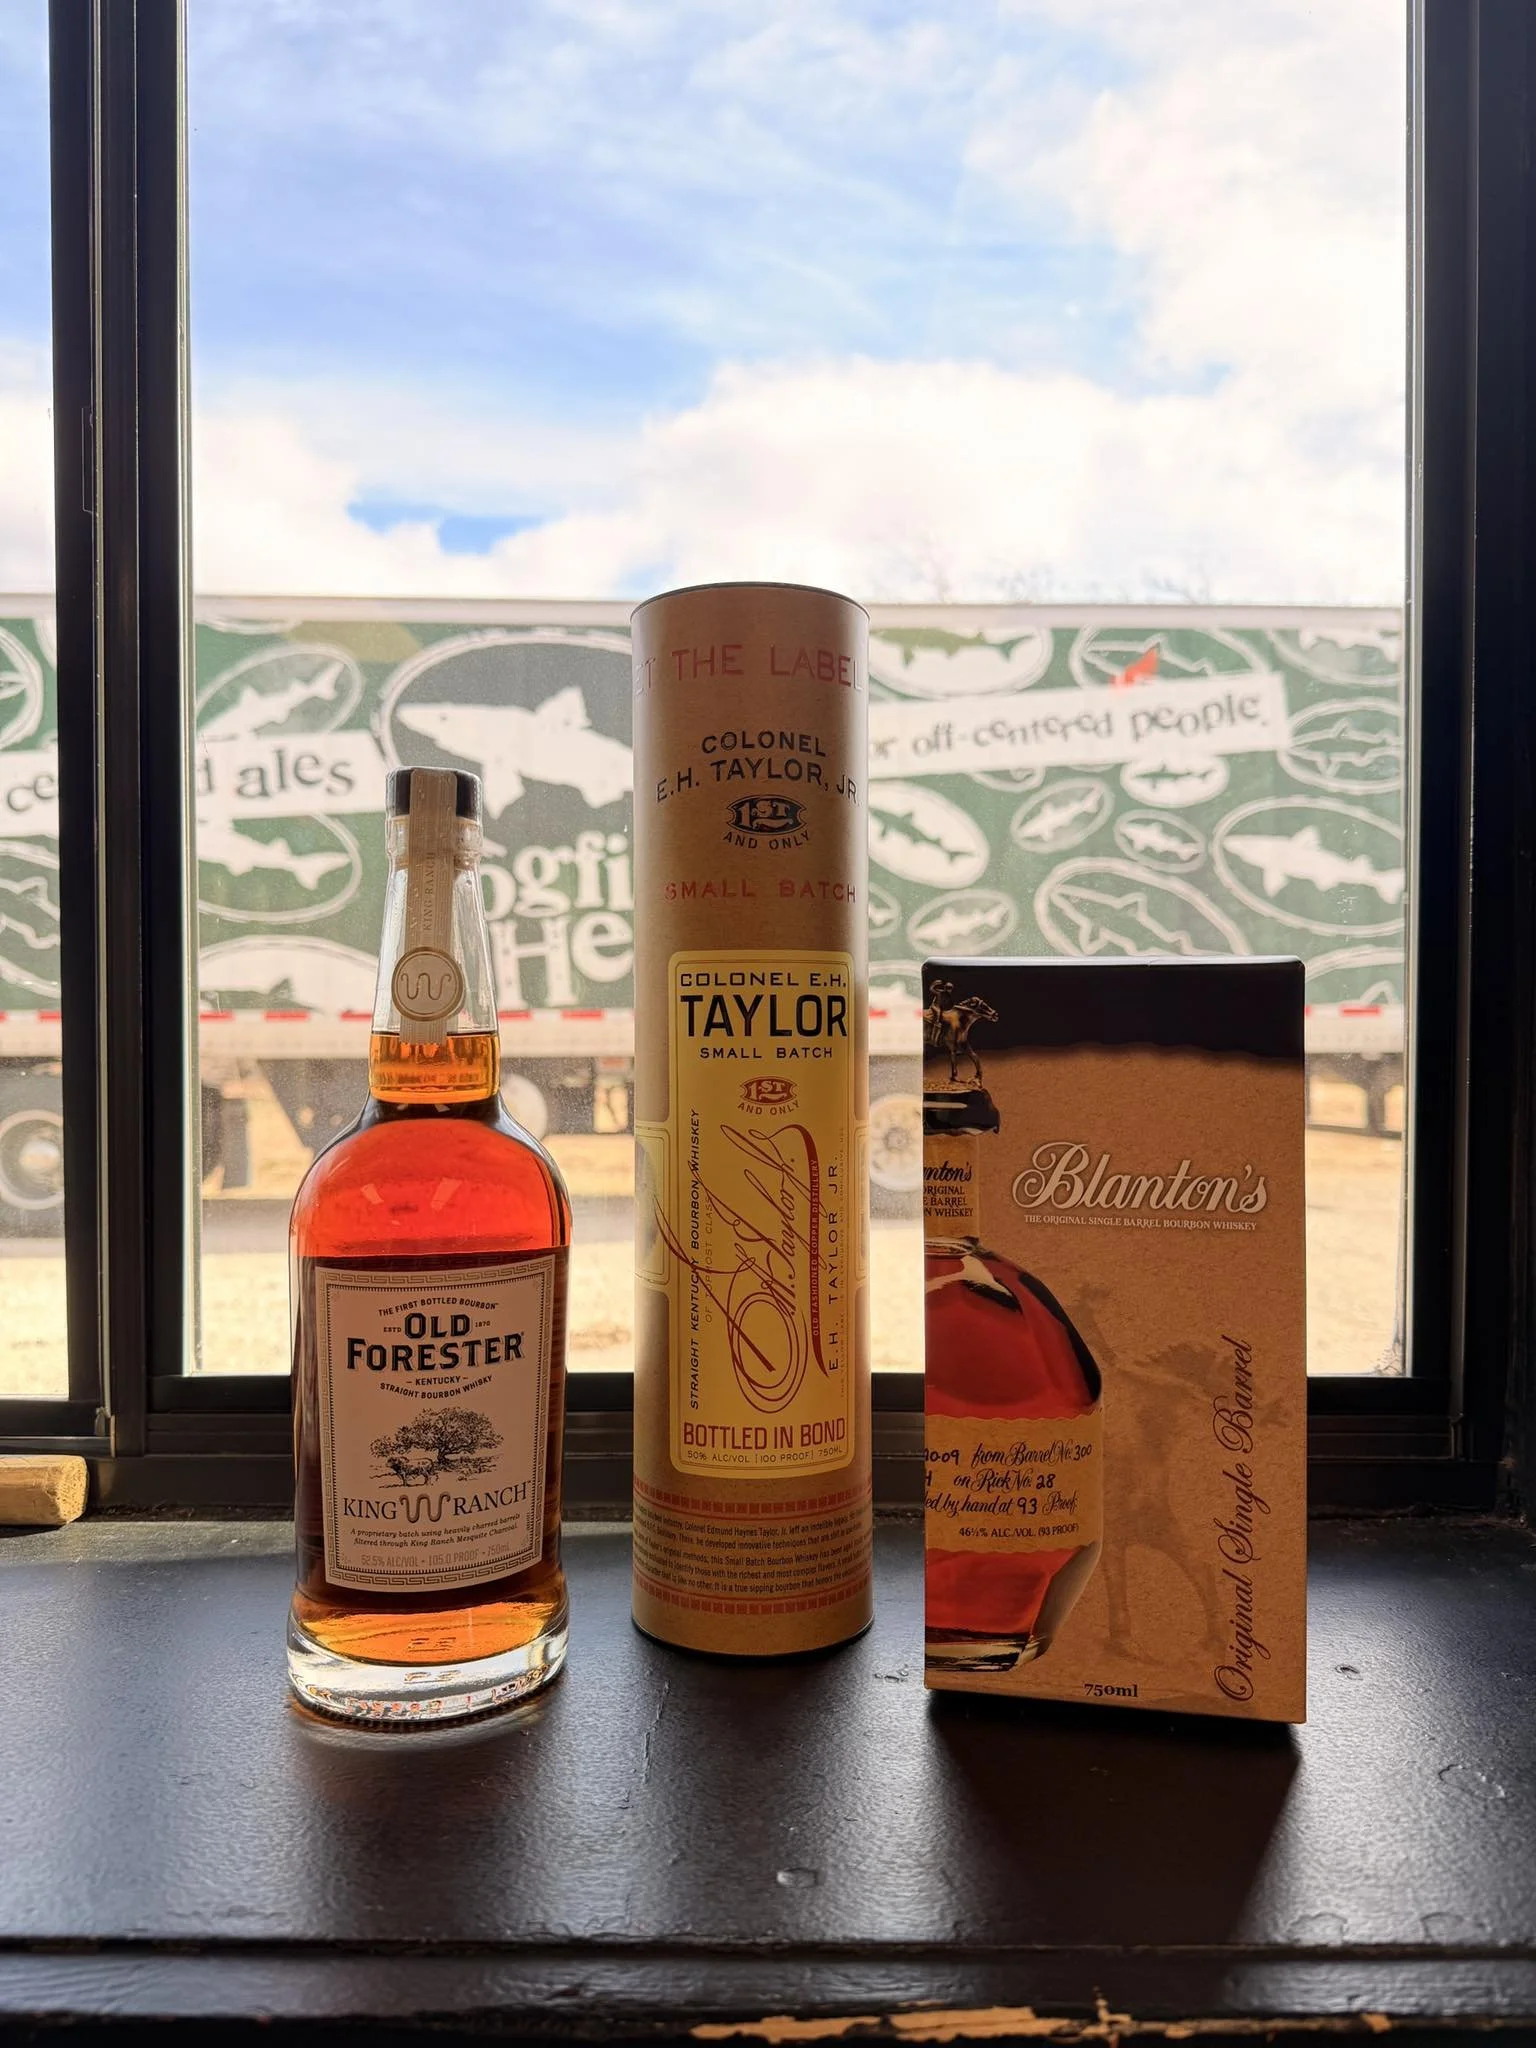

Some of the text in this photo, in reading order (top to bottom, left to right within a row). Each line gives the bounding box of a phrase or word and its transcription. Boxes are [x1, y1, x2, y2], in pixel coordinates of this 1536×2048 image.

[671, 644, 744, 681] THE
[770, 645, 863, 691] LABEL
[912, 712, 1113, 757] off-centered
[1130, 693, 1268, 742] people.
[702, 731, 826, 757] COLONEL
[235, 749, 356, 799] ales
[657, 768, 700, 803] E.H.
[710, 758, 829, 791] TAYLOR,
[739, 800, 791, 828] 1ST
[723, 830, 810, 850] AND ONLY
[479, 830, 634, 921] ogfi
[664, 879, 856, 903] SMALL BATCH
[423, 900, 433, 931] KING
[489, 910, 634, 1009] He
[681, 973, 847, 987] COLONEL E.H.
[680, 994, 848, 1037] TAYLOR
[700, 1047, 832, 1059] SMALL BATCH
[750, 1080, 786, 1101] 1ST
[737, 1100, 799, 1116] AND ONLY
[811, 1160, 819, 1213] DISTILLERY
[1012, 1141, 1268, 1214] Blanton's
[931, 1197, 967, 1207] BARREL
[934, 1207, 973, 1217] WHISKEY
[1024, 1214, 1257, 1231] THE ORIGINAL SINGLE BARREL BOURBON WHISKEY
[690, 1109, 700, 1410] STRAIGHT KENTUCKY BOURBON WHISKEY
[829, 1157, 838, 1370] E.H. TAYLOR JR.
[811, 1260, 819, 1313] FASHIONED
[378, 1307, 394, 1317] THE
[395, 1300, 418, 1313] FIRST
[421, 1297, 458, 1306] BOTTLED
[404, 1312, 471, 1339] OLD
[475, 1320, 491, 1328] 1870
[347, 1333, 524, 1372] FORESTER
[380, 1375, 493, 1399] STRAIGHT BOURBON WHISKY
[415, 1376, 462, 1386] KENTUCKY
[684, 1417, 846, 1450] BOTTLED IN BOND
[687, 1450, 706, 1461] 50%
[712, 1453, 750, 1463] ALC/VOL
[971, 1442, 1004, 1469] from
[1005, 1441, 1054, 1467] Barrel
[1073, 1444, 1092, 1461] 300
[954, 1476, 970, 1488] on
[970, 1468, 1010, 1493] Rick
[1036, 1473, 1056, 1489] 28
[343, 1497, 398, 1520] KING
[942, 1493, 960, 1518] by
[959, 1495, 999, 1513] hand
[998, 1498, 1014, 1516] at
[1017, 1497, 1037, 1515] 93
[1212, 1334, 1272, 1701] Original Single Barrel
[399, 1529, 420, 1538] batch
[421, 1529, 442, 1538] using
[707, 1525, 733, 1535] Edmund
[735, 1527, 758, 1537] Haynes
[1052, 1523, 1080, 1535] PROOF)
[379, 1539, 408, 1548] through
[410, 1539, 428, 1548] King
[430, 1537, 454, 1546] Ranch
[704, 1539, 736, 1550] developed
[725, 1556, 744, 1566] Small
[745, 1557, 765, 1566] Batch
[767, 1557, 793, 1566] Bourbon
[712, 1568, 726, 1577] with
[727, 1570, 738, 1579] the
[739, 1570, 761, 1580] richest
[763, 1571, 775, 1579] and
[776, 1570, 792, 1578] most
[734, 1583, 749, 1592] true
[750, 1583, 774, 1594] sipping
[775, 1582, 800, 1591] bourbon
[1084, 1684, 1138, 1698] 750ml
